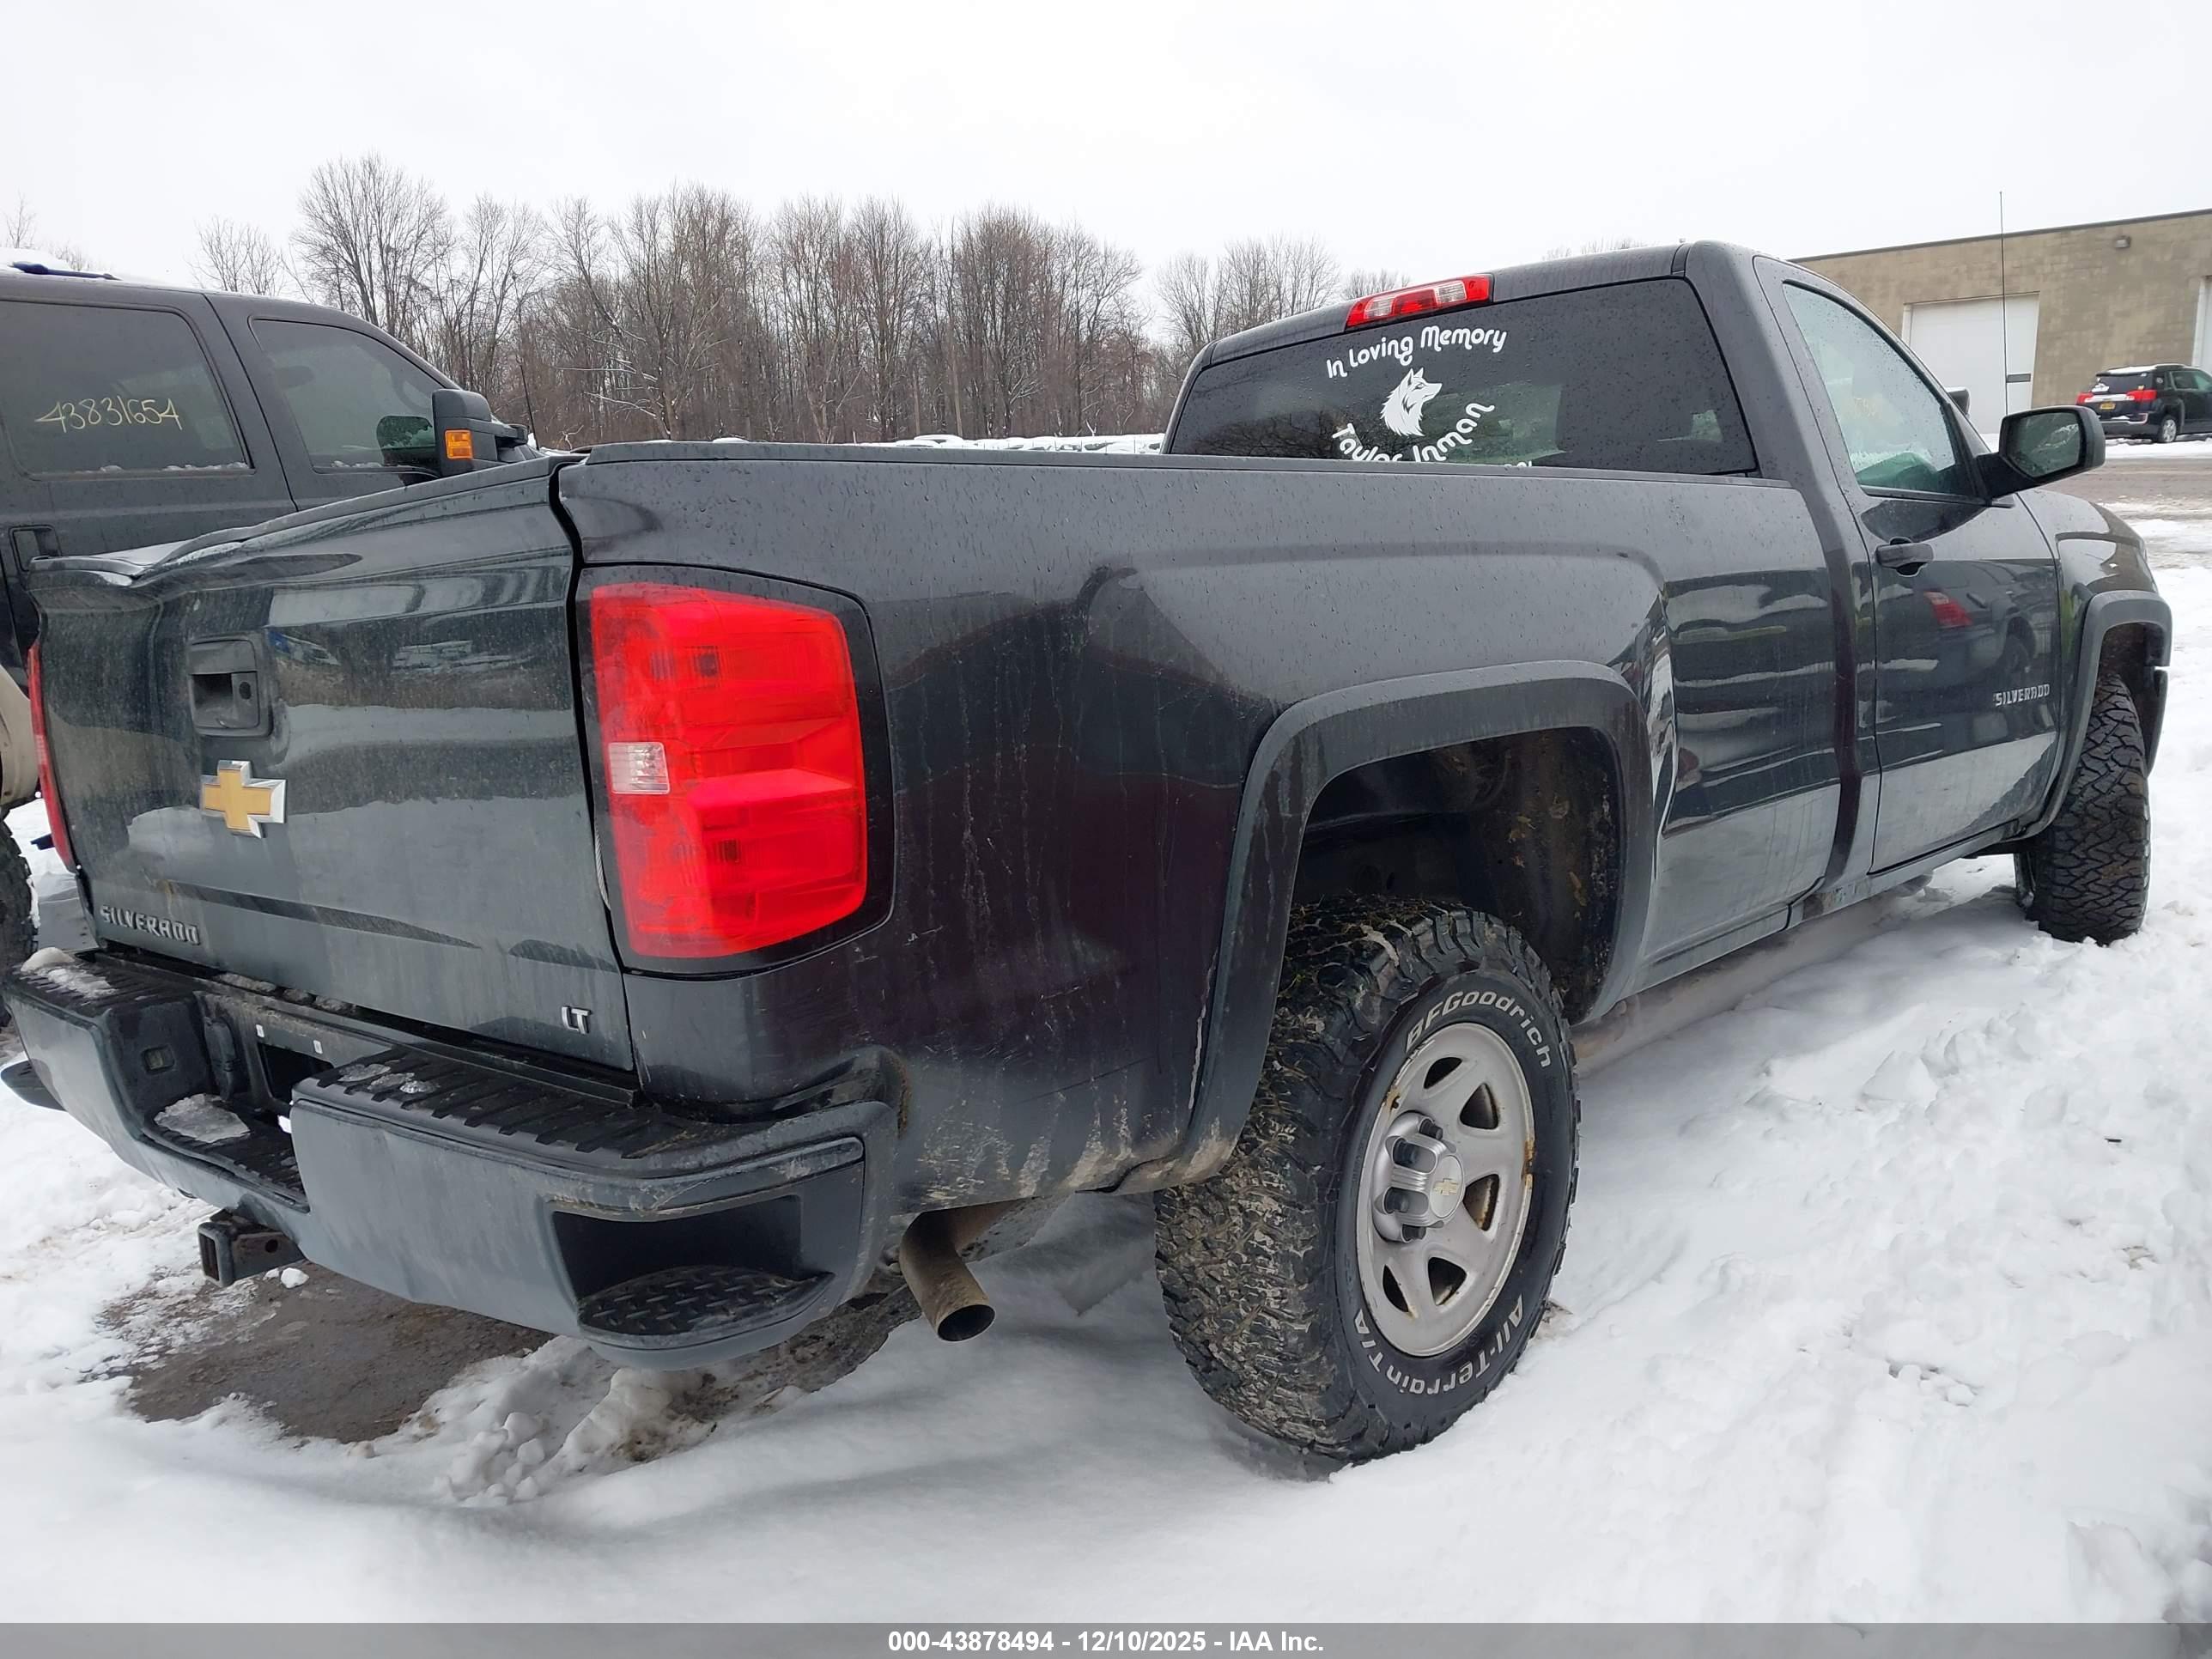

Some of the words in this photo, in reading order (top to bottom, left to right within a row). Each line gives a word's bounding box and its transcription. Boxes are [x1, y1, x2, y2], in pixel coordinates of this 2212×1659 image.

[1326, 359, 1348, 378] In
[1349, 336, 1413, 366] Loving
[1420, 325, 1507, 353] Memory
[34, 395, 183, 433] 43831654
[1413, 403, 1495, 463] Inman
[1993, 684, 2051, 707] SILVERADO
[100, 904, 200, 945] SILVERADO
[562, 1006, 591, 1035] LT
[1406, 990, 1552, 1068] BFGoodrich
[1353, 1308, 1384, 1373] T/A
[1386, 1293, 1524, 1395] All-Terrain
